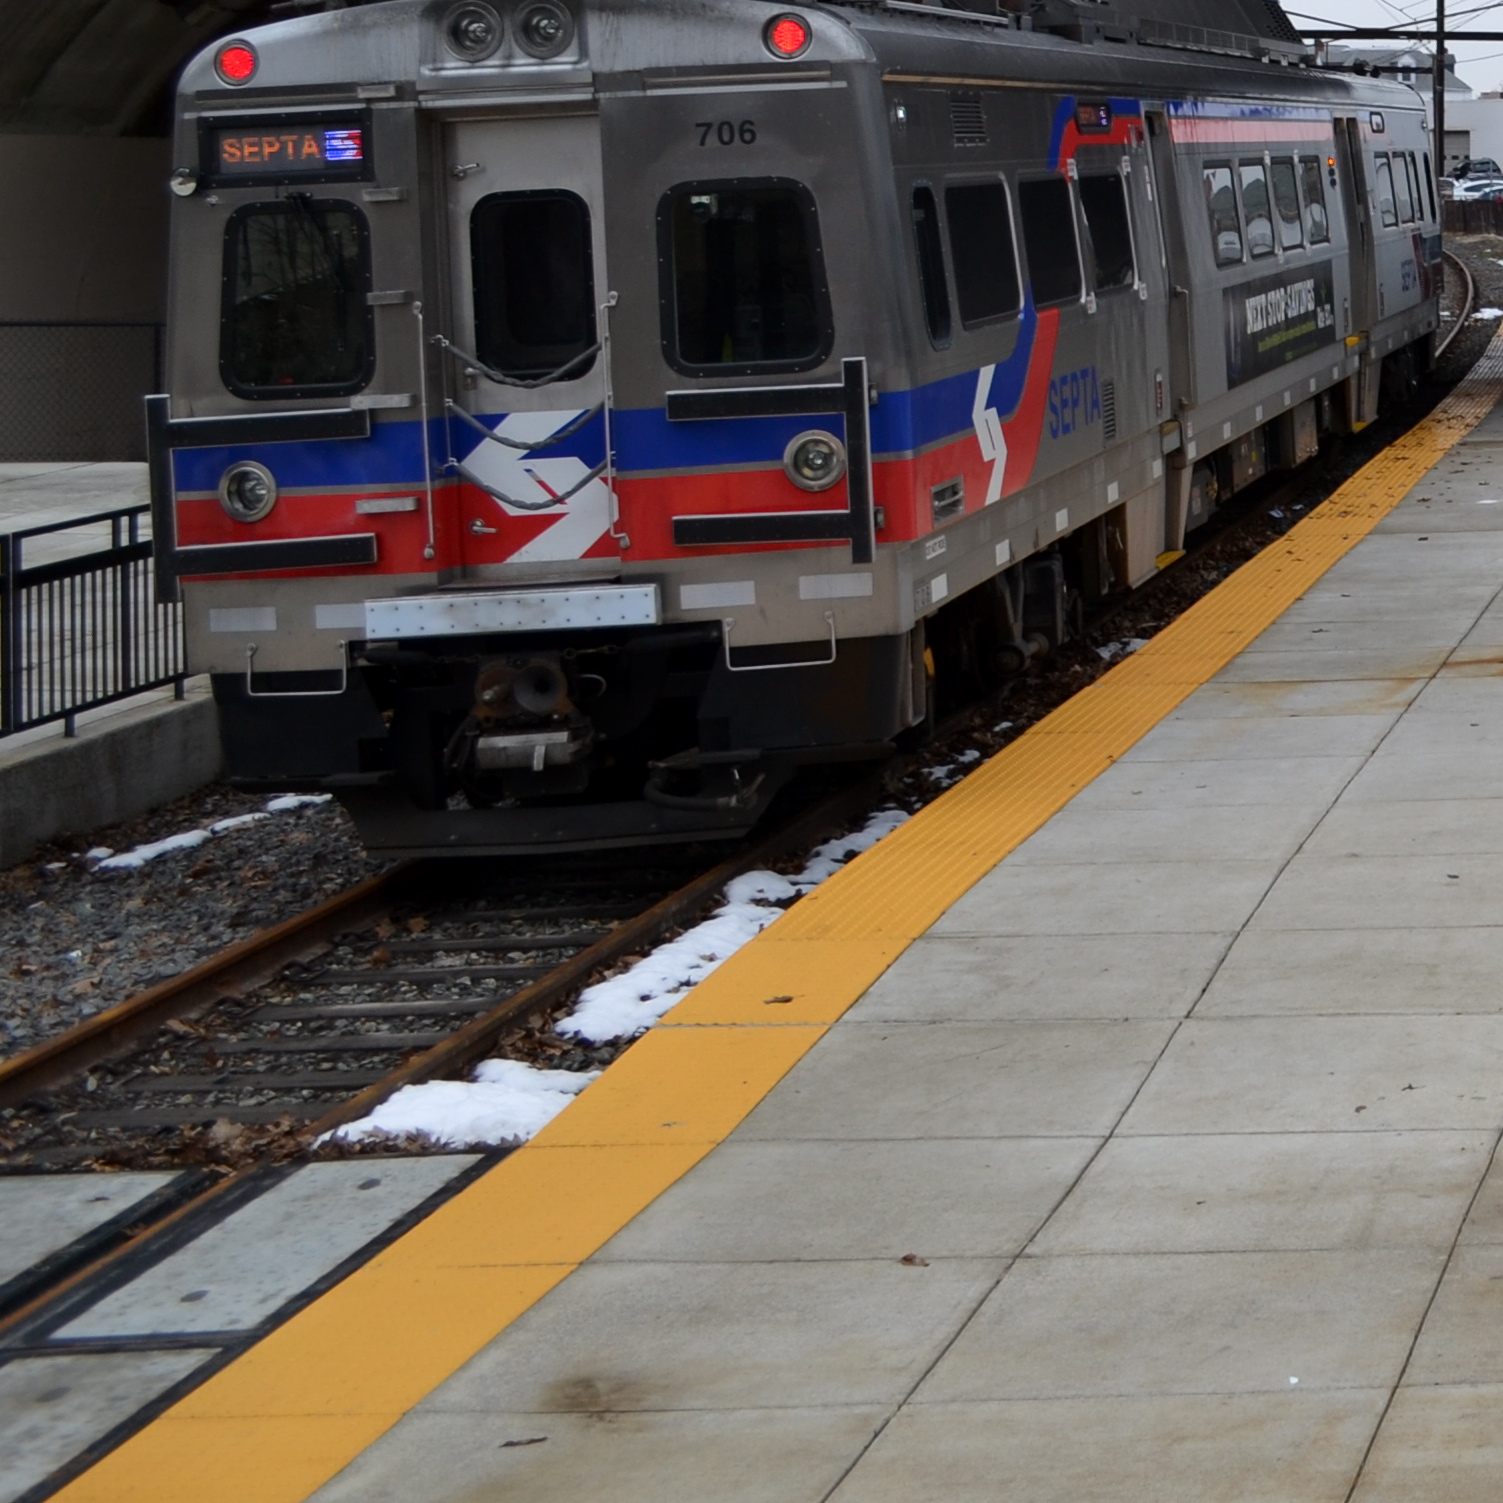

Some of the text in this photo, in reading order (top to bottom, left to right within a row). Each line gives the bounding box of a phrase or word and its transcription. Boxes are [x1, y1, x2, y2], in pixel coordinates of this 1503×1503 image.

[695, 119, 757, 147] 706
[222, 134, 321, 163] SEPTA
[1050, 365, 1101, 440] SEPTA
